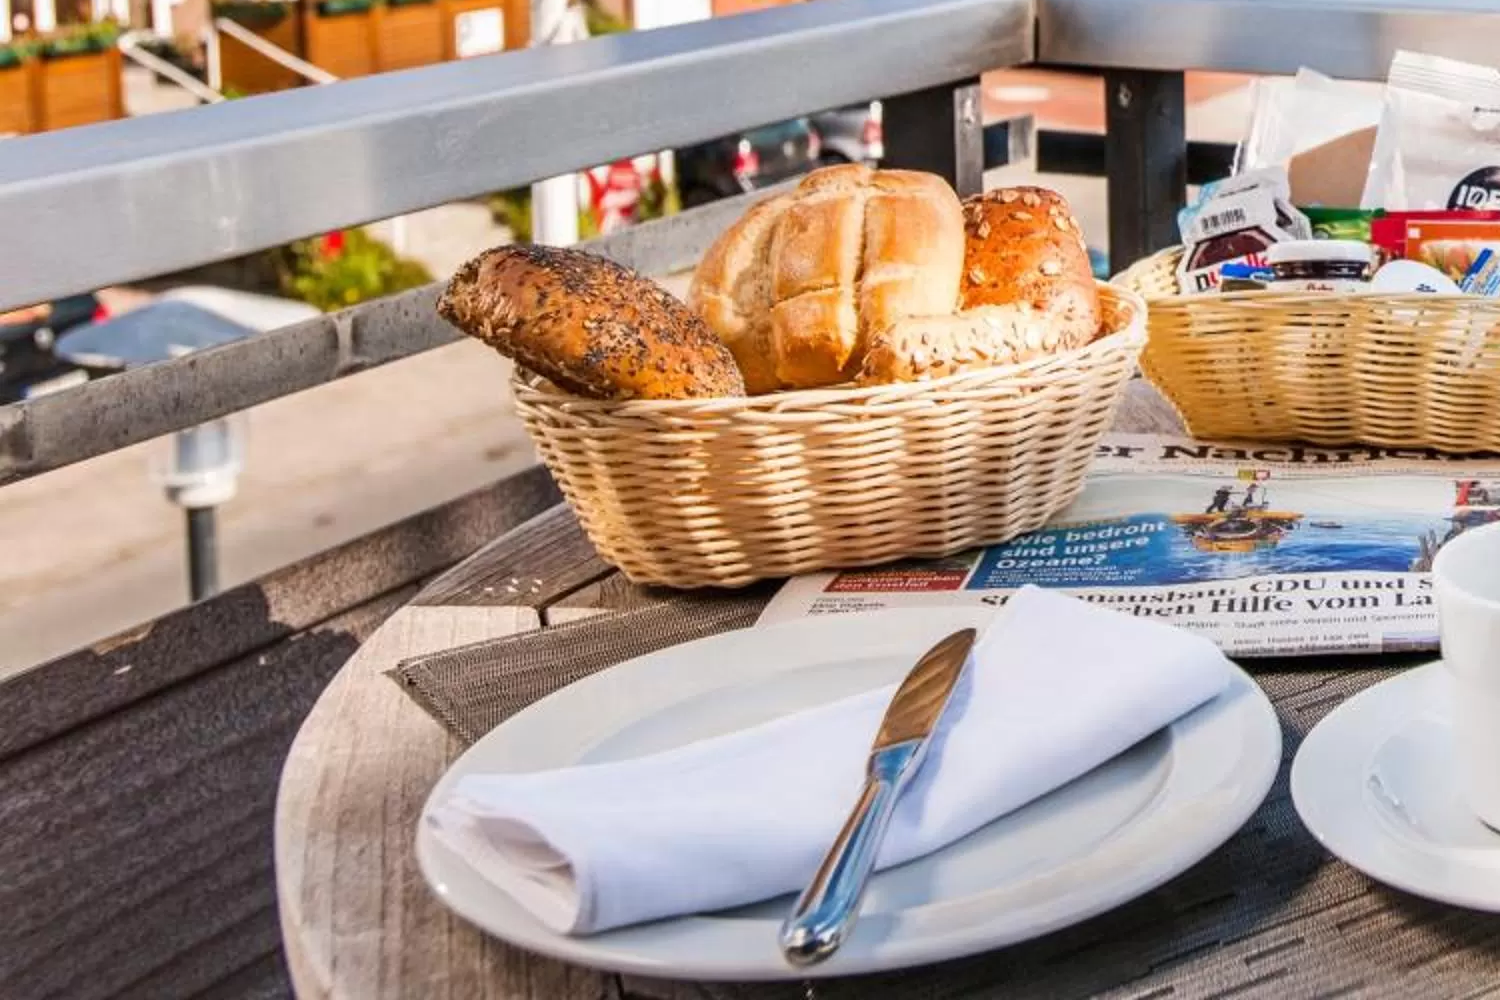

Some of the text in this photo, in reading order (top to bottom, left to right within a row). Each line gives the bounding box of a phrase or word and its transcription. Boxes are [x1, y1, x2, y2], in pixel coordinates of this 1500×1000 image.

[1065, 521, 1168, 543] bedroht
[1001, 536, 1150, 559] sind unsere
[996, 554, 1108, 571] Ozeane?
[1249, 578, 1327, 593] CDU
[1340, 577, 1405, 590] und
[1418, 579, 1434, 590] S
[1211, 594, 1294, 614] Hilfe
[1306, 596, 1380, 611] vom
[1395, 593, 1434, 607] La
